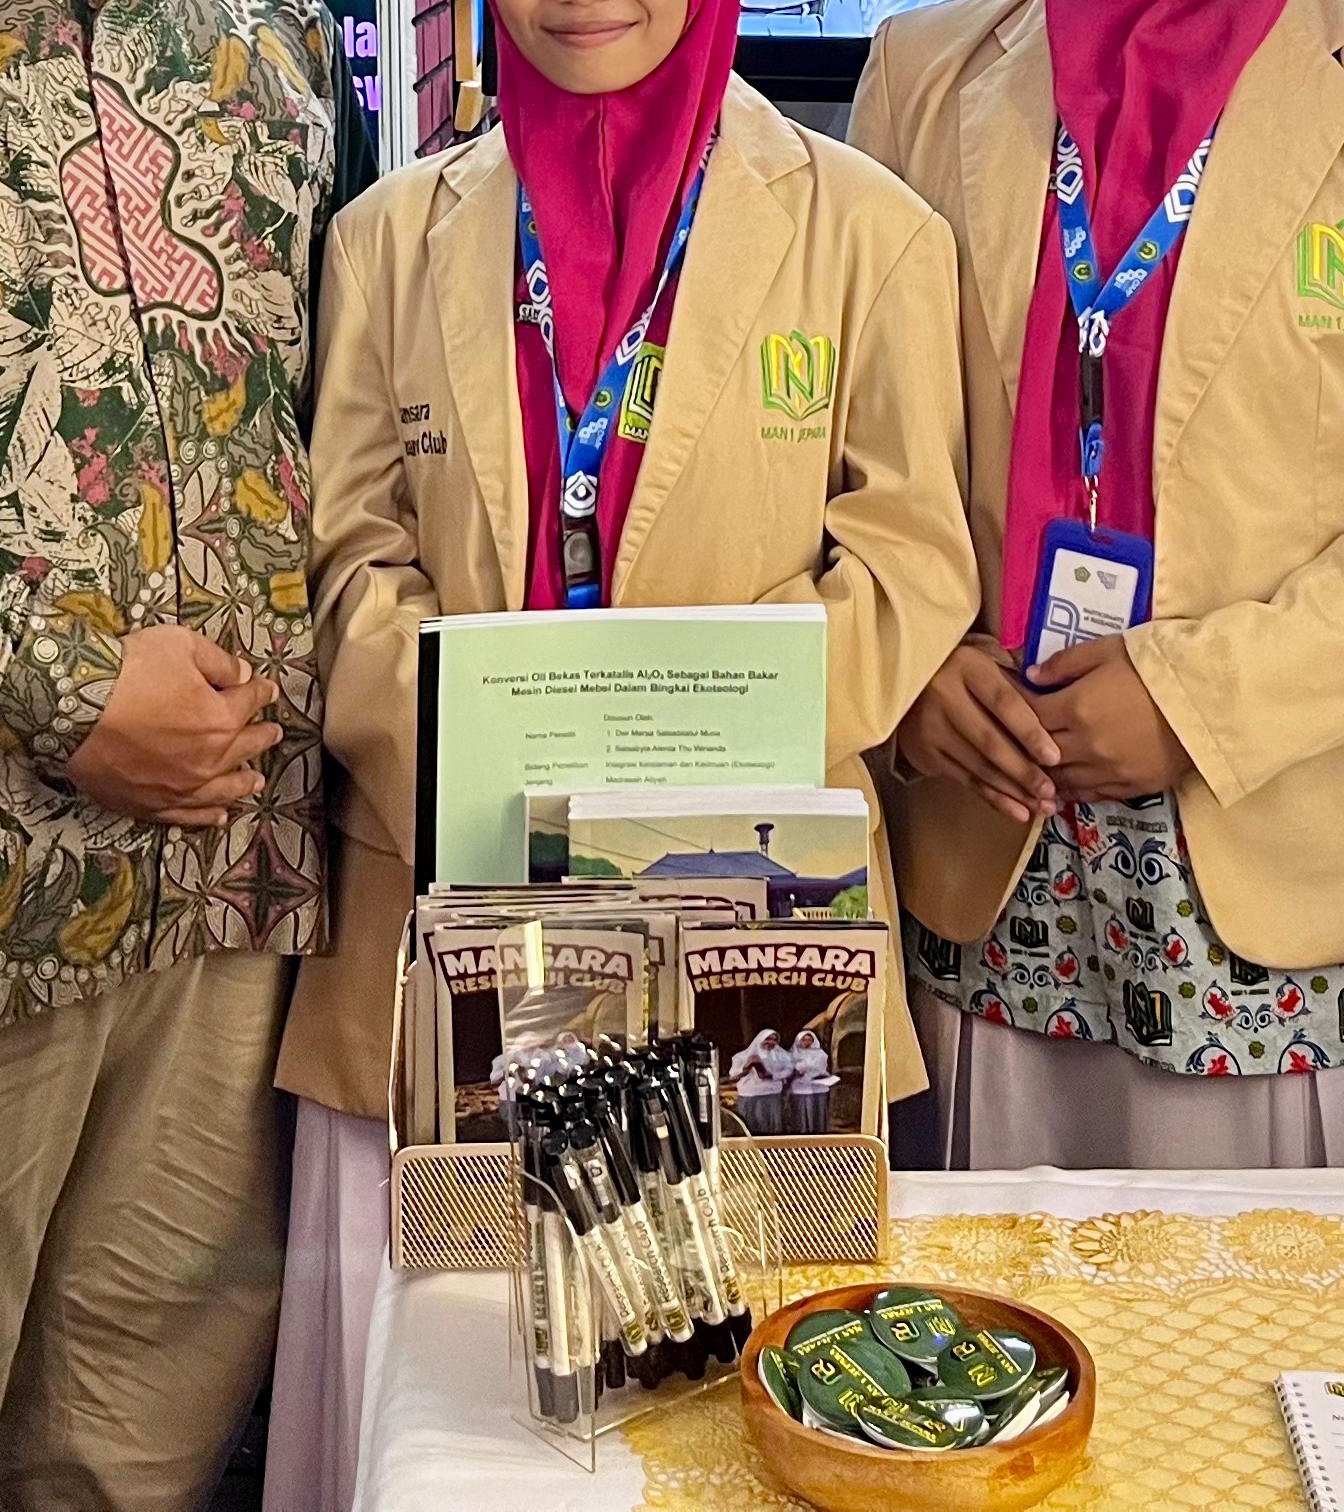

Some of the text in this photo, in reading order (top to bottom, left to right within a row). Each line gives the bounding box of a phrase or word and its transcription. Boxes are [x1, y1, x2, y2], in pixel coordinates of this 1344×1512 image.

[421, 429, 448, 455] Club
[760, 427, 788, 440] MAN
[482, 673, 529, 686] Konversi
[531, 672, 547, 683] Oli
[548, 670, 581, 681] Bekas
[583, 669, 634, 680] Terkatalis
[666, 669, 709, 682] Sebagai
[711, 669, 746, 680] Bahan
[748, 669, 779, 681] Bakar
[511, 686, 543, 697] Mesin
[544, 684, 577, 696] Diesel
[613, 682, 647, 694] Dalam
[649, 682, 691, 695] Bingkai
[692, 682, 749, 696] Ekoteologi
[686, 944, 874, 978] MANSARA
[692, 969, 870, 994] RESEARCH CLUB
